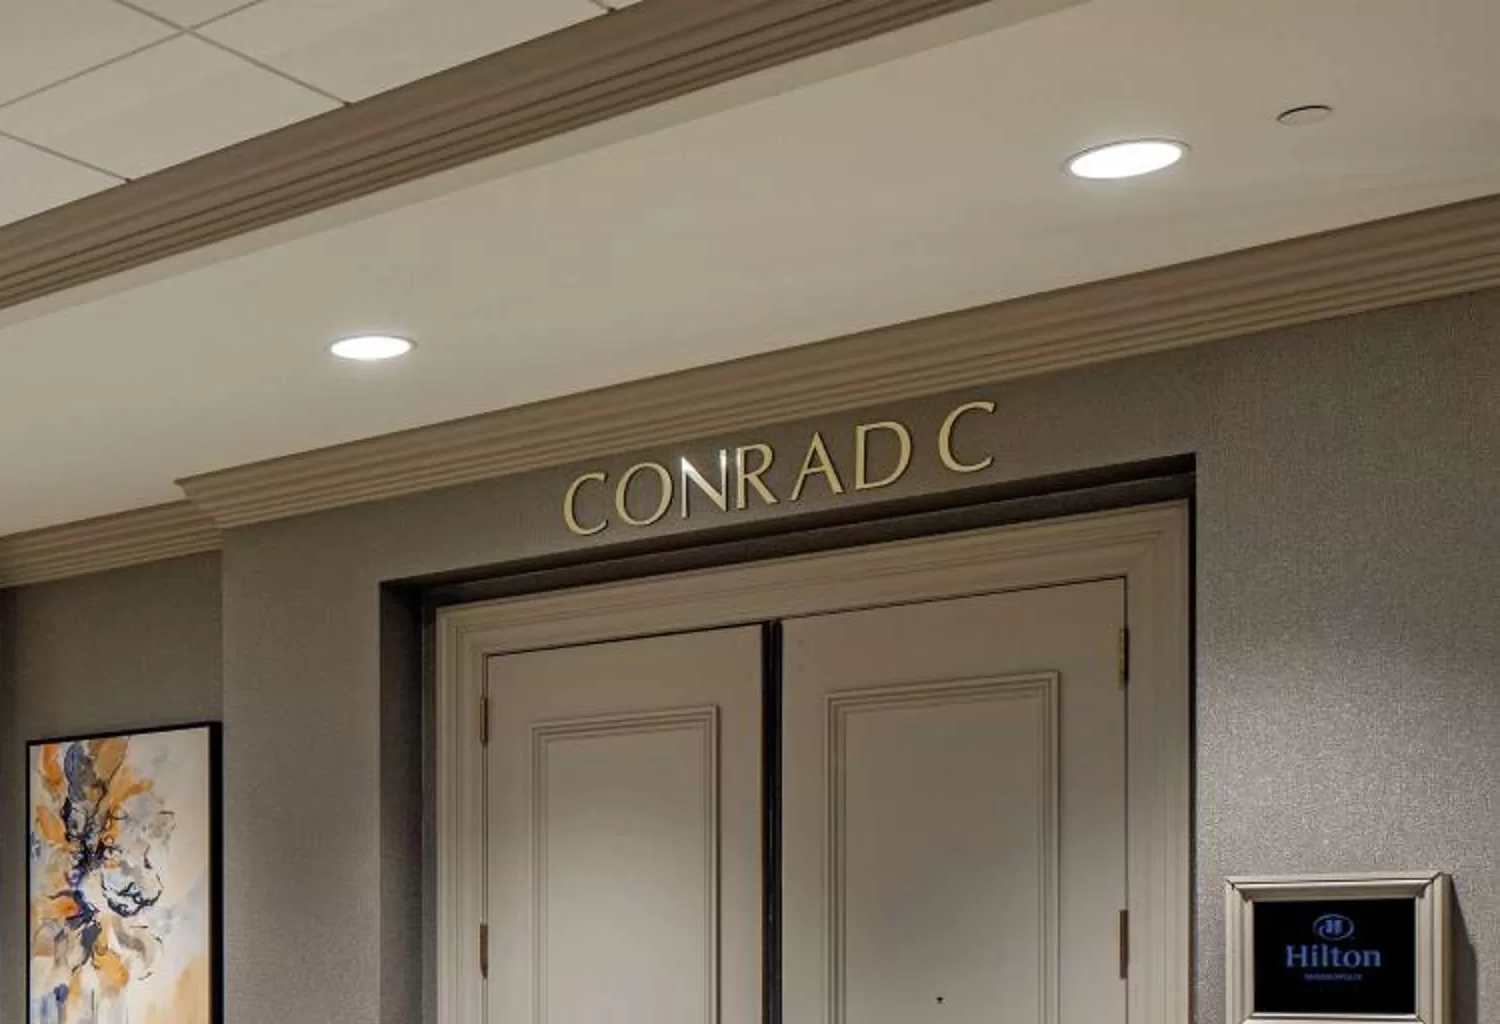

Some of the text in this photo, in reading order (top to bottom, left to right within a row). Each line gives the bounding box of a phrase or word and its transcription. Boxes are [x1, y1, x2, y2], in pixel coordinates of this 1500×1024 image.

[562, 401, 996, 536] CONRAD C
[1285, 943, 1382, 968] Hilton
